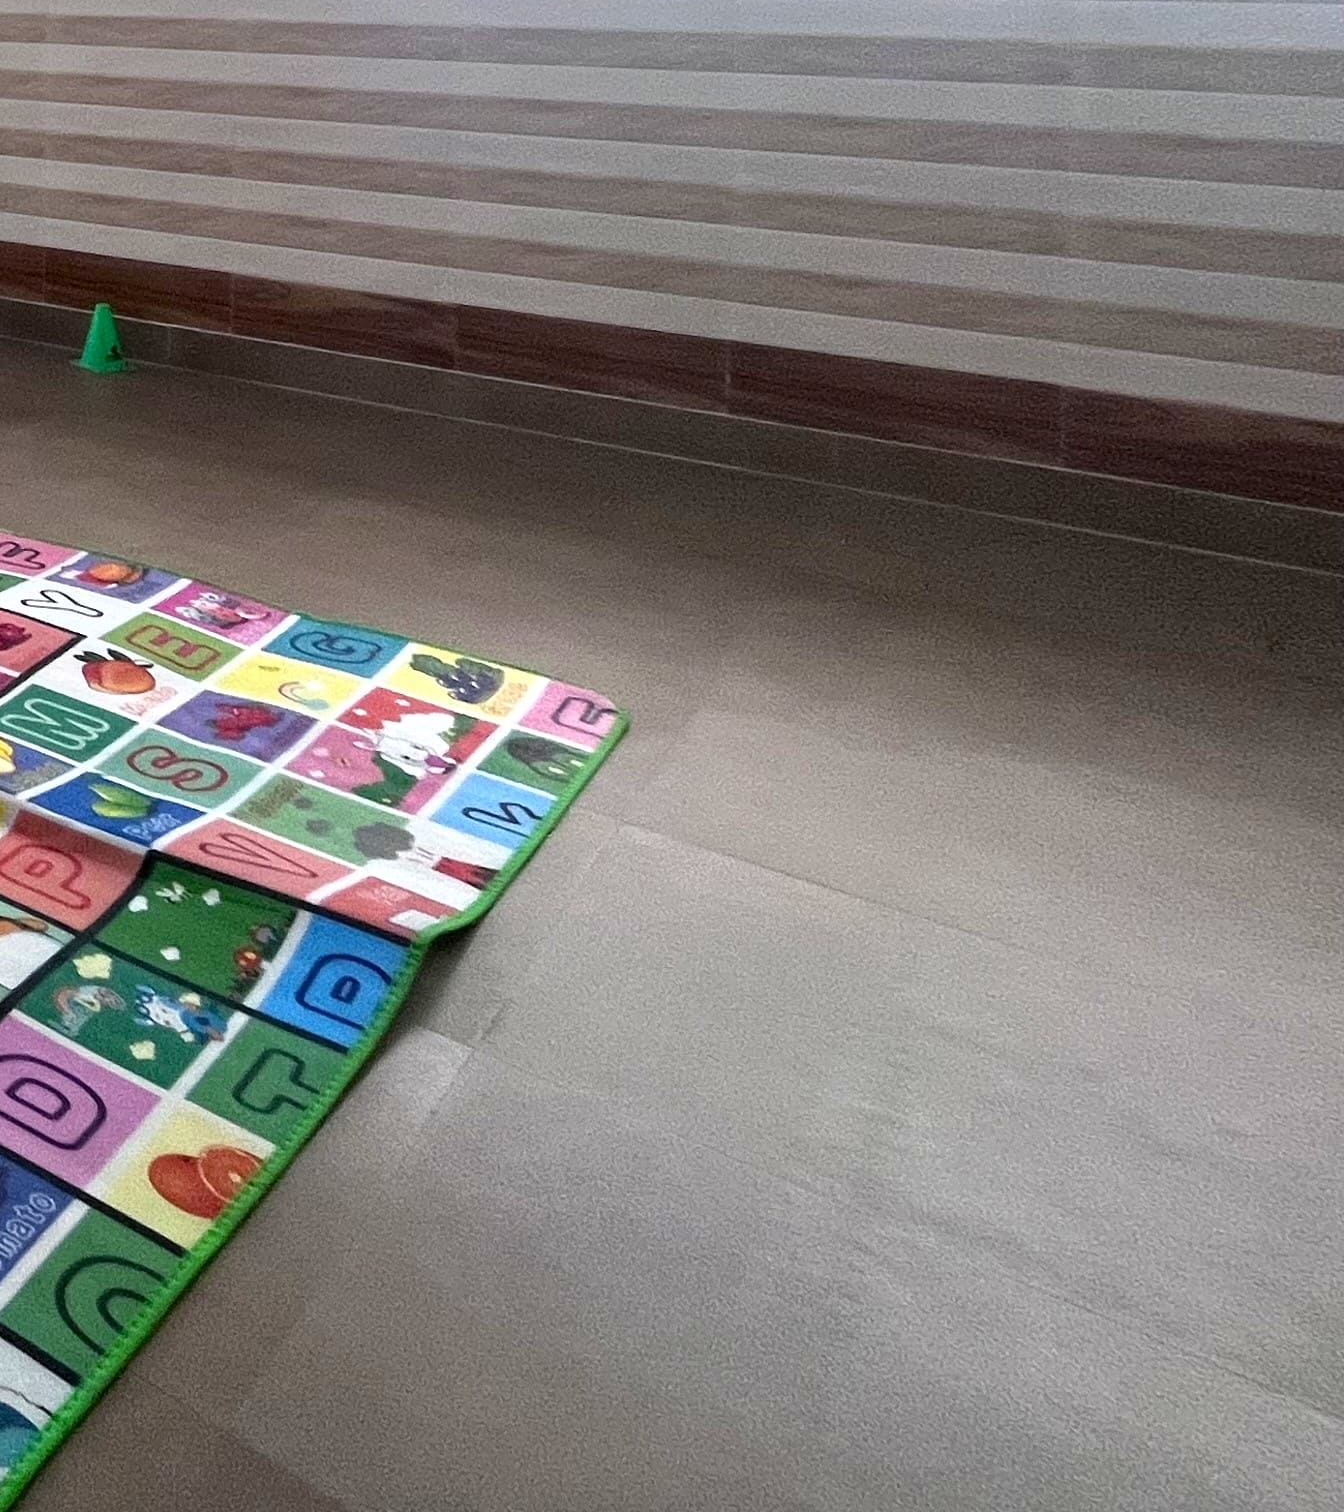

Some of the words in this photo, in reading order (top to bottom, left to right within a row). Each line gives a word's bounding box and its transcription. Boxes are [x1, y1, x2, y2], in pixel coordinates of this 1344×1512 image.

[21, 589, 104, 618] Y
[125, 624, 221, 671] E
[289, 631, 383, 664] G
[0, 698, 111, 750] M
[126, 744, 229, 791] S
[199, 832, 320, 879] V
